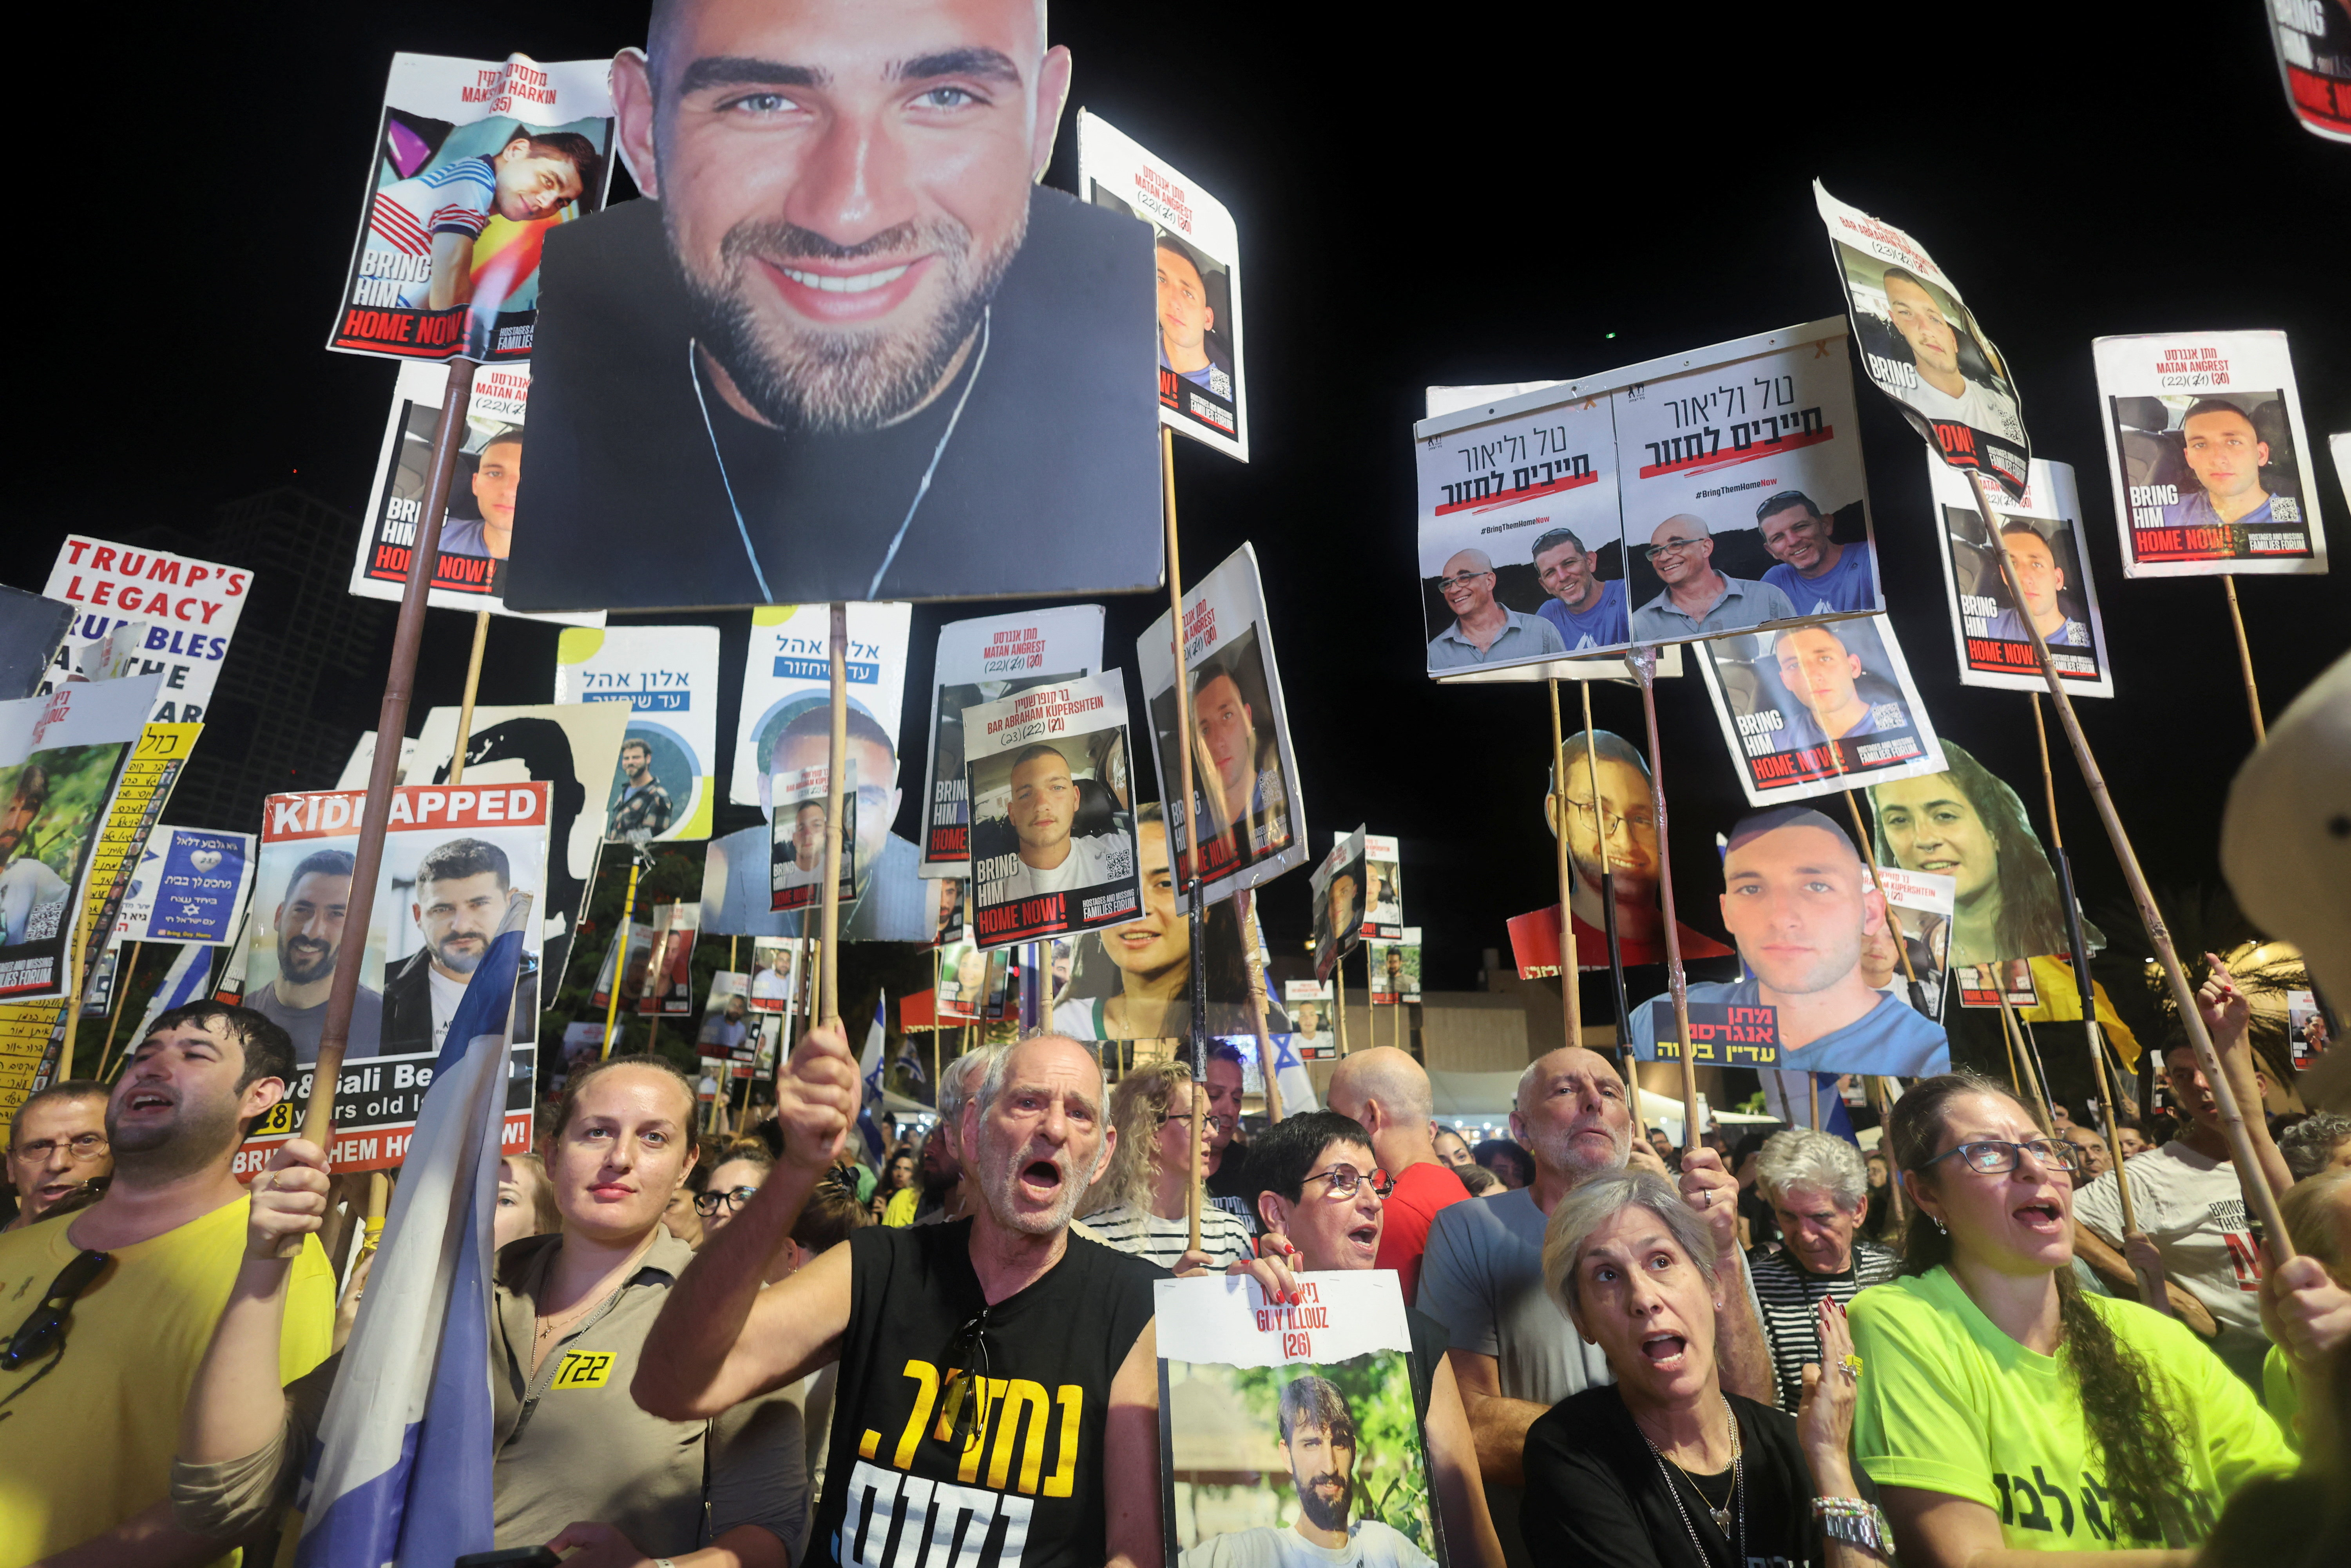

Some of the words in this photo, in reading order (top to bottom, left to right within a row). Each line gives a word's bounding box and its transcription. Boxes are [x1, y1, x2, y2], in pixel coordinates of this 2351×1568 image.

[505, 63, 547, 87] מקסים
[508, 80, 557, 105] HARKIN
[489, 96, 512, 114] (35)
[1135, 173, 1161, 200] MATAN
[1161, 188, 1193, 223] ANGREST
[1172, 184, 1185, 204] מתן
[1839, 216, 1858, 232] BAR
[1858, 224, 1898, 249] ABRAHAM
[361, 249, 432, 282] BRING
[353, 279, 402, 308] HIM
[343, 309, 414, 342] HOME
[415, 308, 474, 345] NOW!
[499, 325, 530, 337] HOSTAGES
[2164, 349, 2198, 361] אנגרסט
[2201, 348, 2217, 360] מתן
[1867, 353, 1917, 389] BRING
[2156, 362, 2187, 374] MATAN
[2190, 360, 2229, 373] ANGREST
[476, 382, 513, 398] MATAN
[1754, 375, 1794, 408] טל
[1190, 400, 1214, 422] FAMILIES
[1215, 413, 1234, 431] FORUM
[1664, 386, 1745, 429] וליאור
[1731, 406, 1824, 450] חייבים
[1534, 425, 1567, 458] טל
[1645, 427, 1721, 468] לחזור
[1458, 437, 1526, 474] וליאור
[1514, 453, 1590, 492] חייבים
[1989, 453, 2013, 474] FAMILIES
[2012, 463, 2026, 485] FORUM
[1442, 469, 1504, 506] לחזור
[1695, 477, 1777, 500] #BringThemHomeNow
[2130, 484, 2179, 507] BRING
[1480, 515, 1550, 536] #BringThemHomeNow
[2133, 507, 2165, 529] HIM
[2136, 530, 2183, 552] HOME
[2186, 525, 2233, 550] NOW!
[2250, 540, 2280, 551] FAMILIES
[2281, 539, 2306, 550] FORUM
[68, 540, 245, 597] TRUMP'S
[437, 555, 496, 584] NOW!
[66, 576, 223, 631] LEGACY
[1196, 598, 1207, 619] מתן
[1961, 594, 1998, 618] BRING
[1023, 627, 1038, 641] מתן
[1190, 608, 1215, 640] ANGREST
[1965, 617, 1989, 638] HIM
[776, 634, 822, 655] אהל
[993, 629, 1022, 644] אנגרסט
[984, 645, 1010, 660] MATAN
[1011, 639, 1046, 657] ANGREST
[1968, 640, 2003, 663] HOME
[848, 663, 870, 681] עד
[2053, 660, 2076, 673] FAMILIES
[2076, 662, 2096, 674] FORUM
[583, 671, 630, 688] אהל
[641, 670, 689, 692] אלון
[659, 693, 681, 708] עד
[1014, 690, 1053, 713] קופרשטיין
[1053, 688, 1070, 704] בר
[152, 701, 203, 723] AR
[987, 719, 1003, 735] BAR
[1004, 708, 1043, 732] ABRAHAM
[1045, 695, 1104, 719] KUPERSHTEIN
[1736, 709, 1784, 737] BRING
[1742, 733, 1776, 757] HIM
[1860, 749, 1892, 764] FAMILIES
[1891, 744, 1918, 758] FORUM
[1751, 753, 1798, 780] HOME
[1798, 740, 1846, 775] NOW!
[273, 789, 537, 835] KIDAPPED
[933, 803, 958, 825] HIM
[931, 828, 966, 851] HOME
[977, 854, 1018, 883] BRING
[164, 875, 190, 887] בבית
[1891, 881, 1936, 897] KUPERSHTEIN
[977, 880, 1004, 908] HIM
[1082, 895, 1106, 908] HOSTAGES
[1106, 893, 1116, 903] AND
[1116, 888, 1135, 901] MISSING
[979, 902, 1020, 934] HOME
[1022, 892, 1067, 925] NOW!
[1083, 902, 1113, 920] FAMILIES
[1113, 896, 1136, 913] FORUM
[18, 967, 53, 986] FORUM
[1727, 1007, 1773, 1025] מתן
[1726, 1045, 1775, 1062] עדיין
[366, 1094, 404, 1117] old
[328, 1137, 377, 1164] HEM
[2208, 1199, 2245, 1217] BRING
[1257, 1307, 1283, 1332] GUY
[1288, 1307, 1329, 1330] ILLOUZ
[1282, 1331, 1311, 1359] (26)
[559, 1353, 610, 1384] 722
